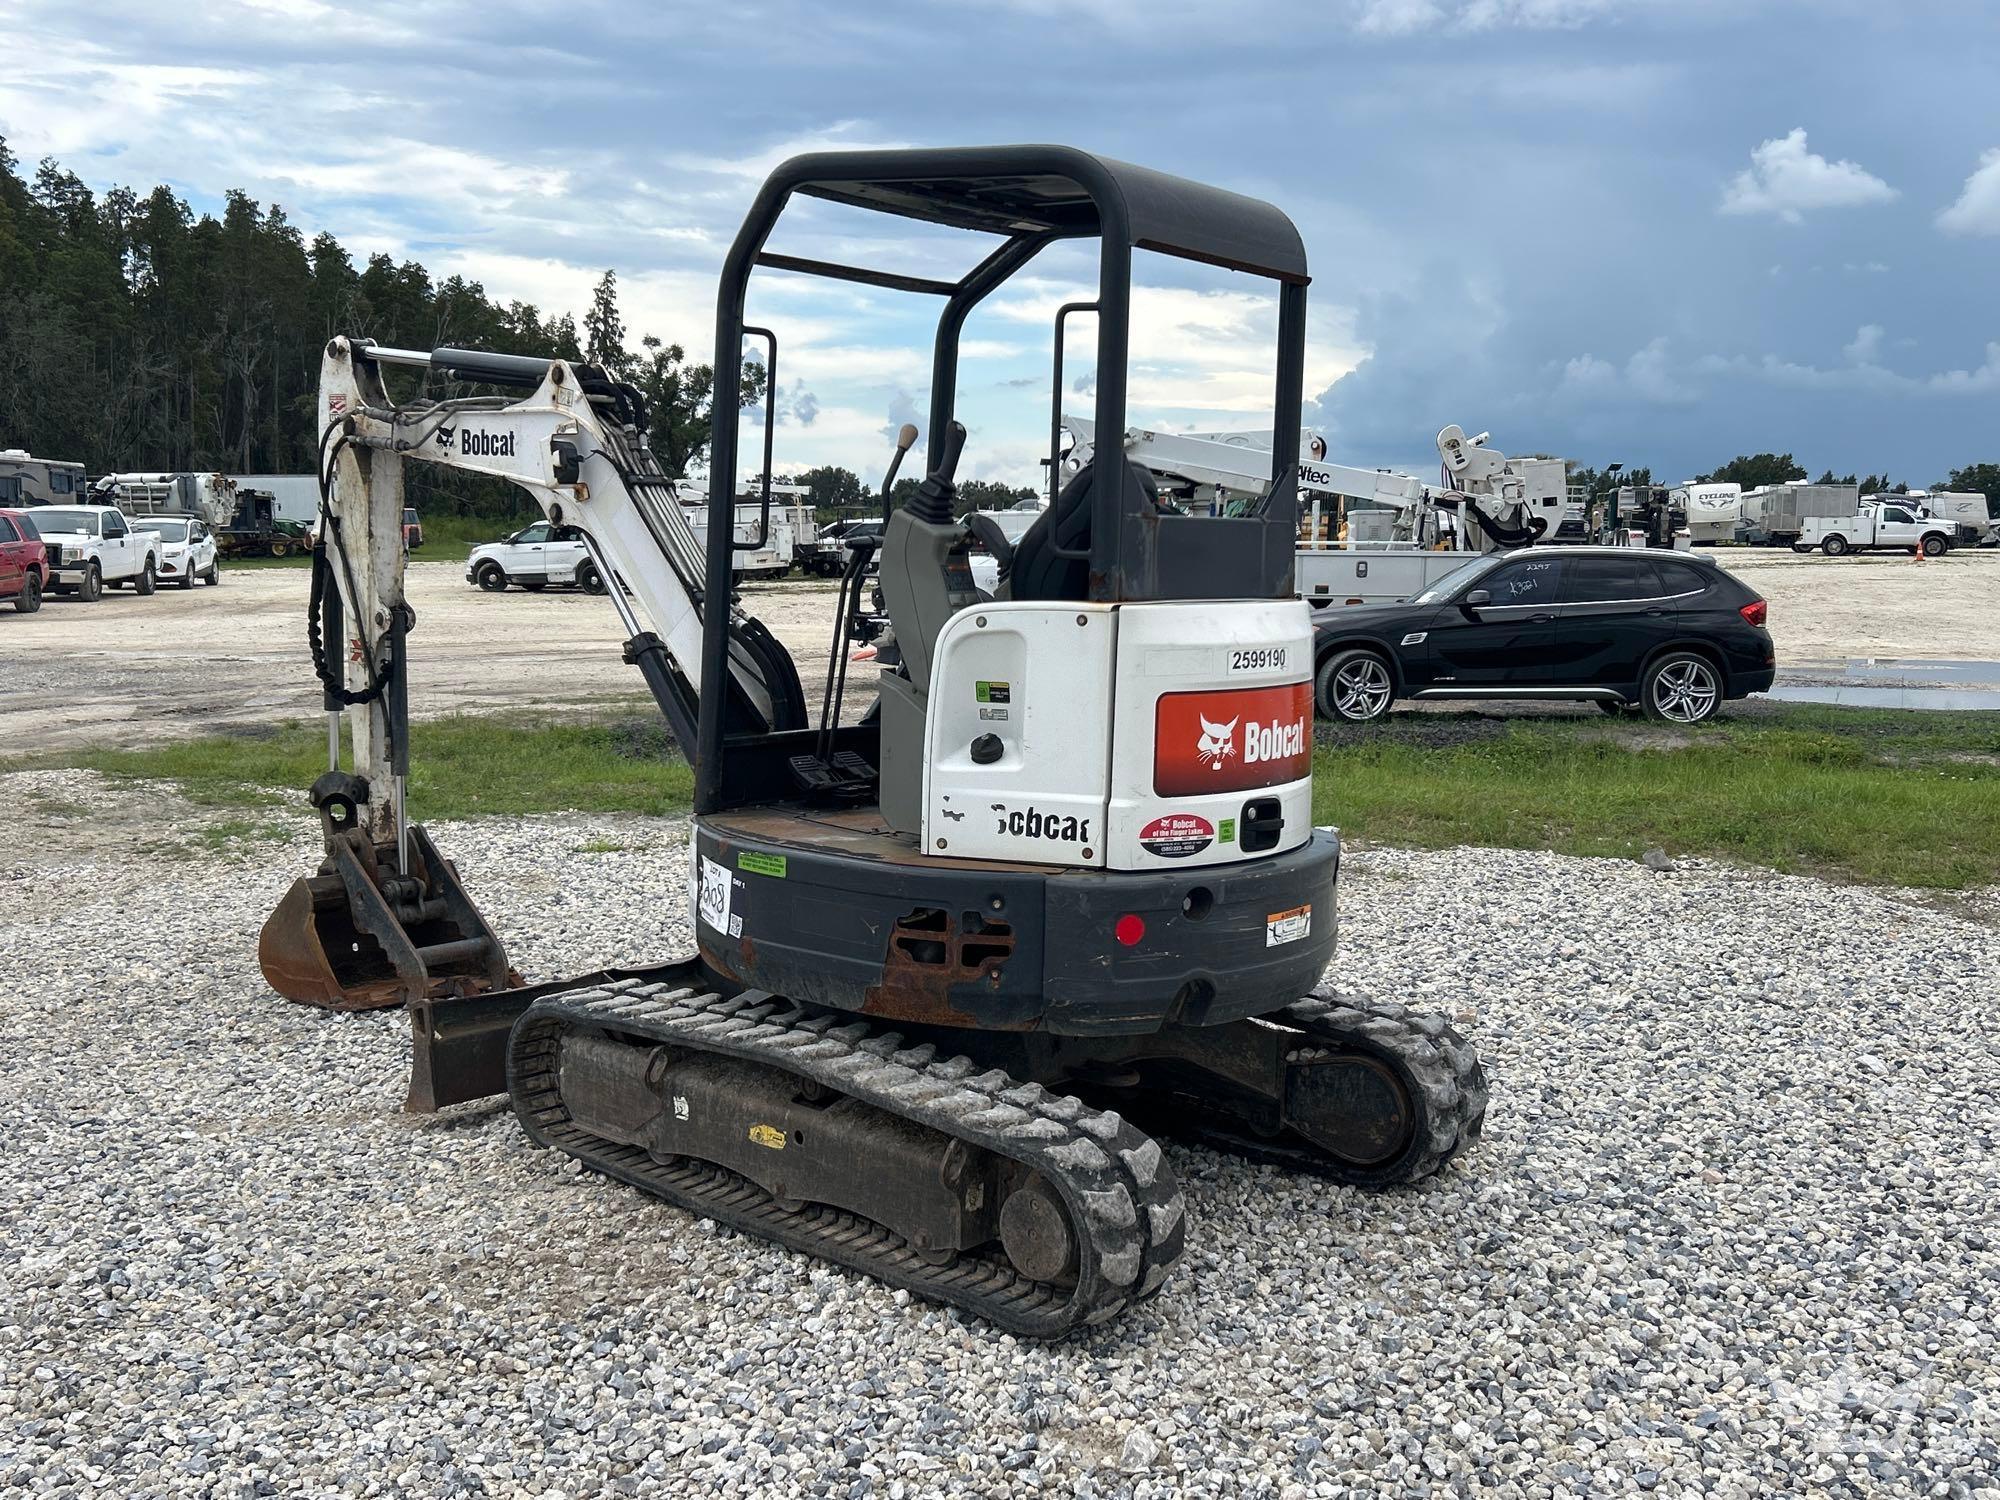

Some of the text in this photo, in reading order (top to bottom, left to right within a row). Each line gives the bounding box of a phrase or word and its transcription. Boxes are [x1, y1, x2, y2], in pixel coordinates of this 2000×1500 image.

[461, 428, 515, 457] Bobcat
[1698, 492, 1736, 500] CYCLONE
[1232, 648, 1286, 670] 2599190
[1243, 715, 1305, 764] Bobcat
[1160, 829, 1169, 837] the
[1170, 829, 1188, 837] Finger
[1188, 827, 1204, 835] Lakes
[1172, 819, 1196, 830] Bobcat
